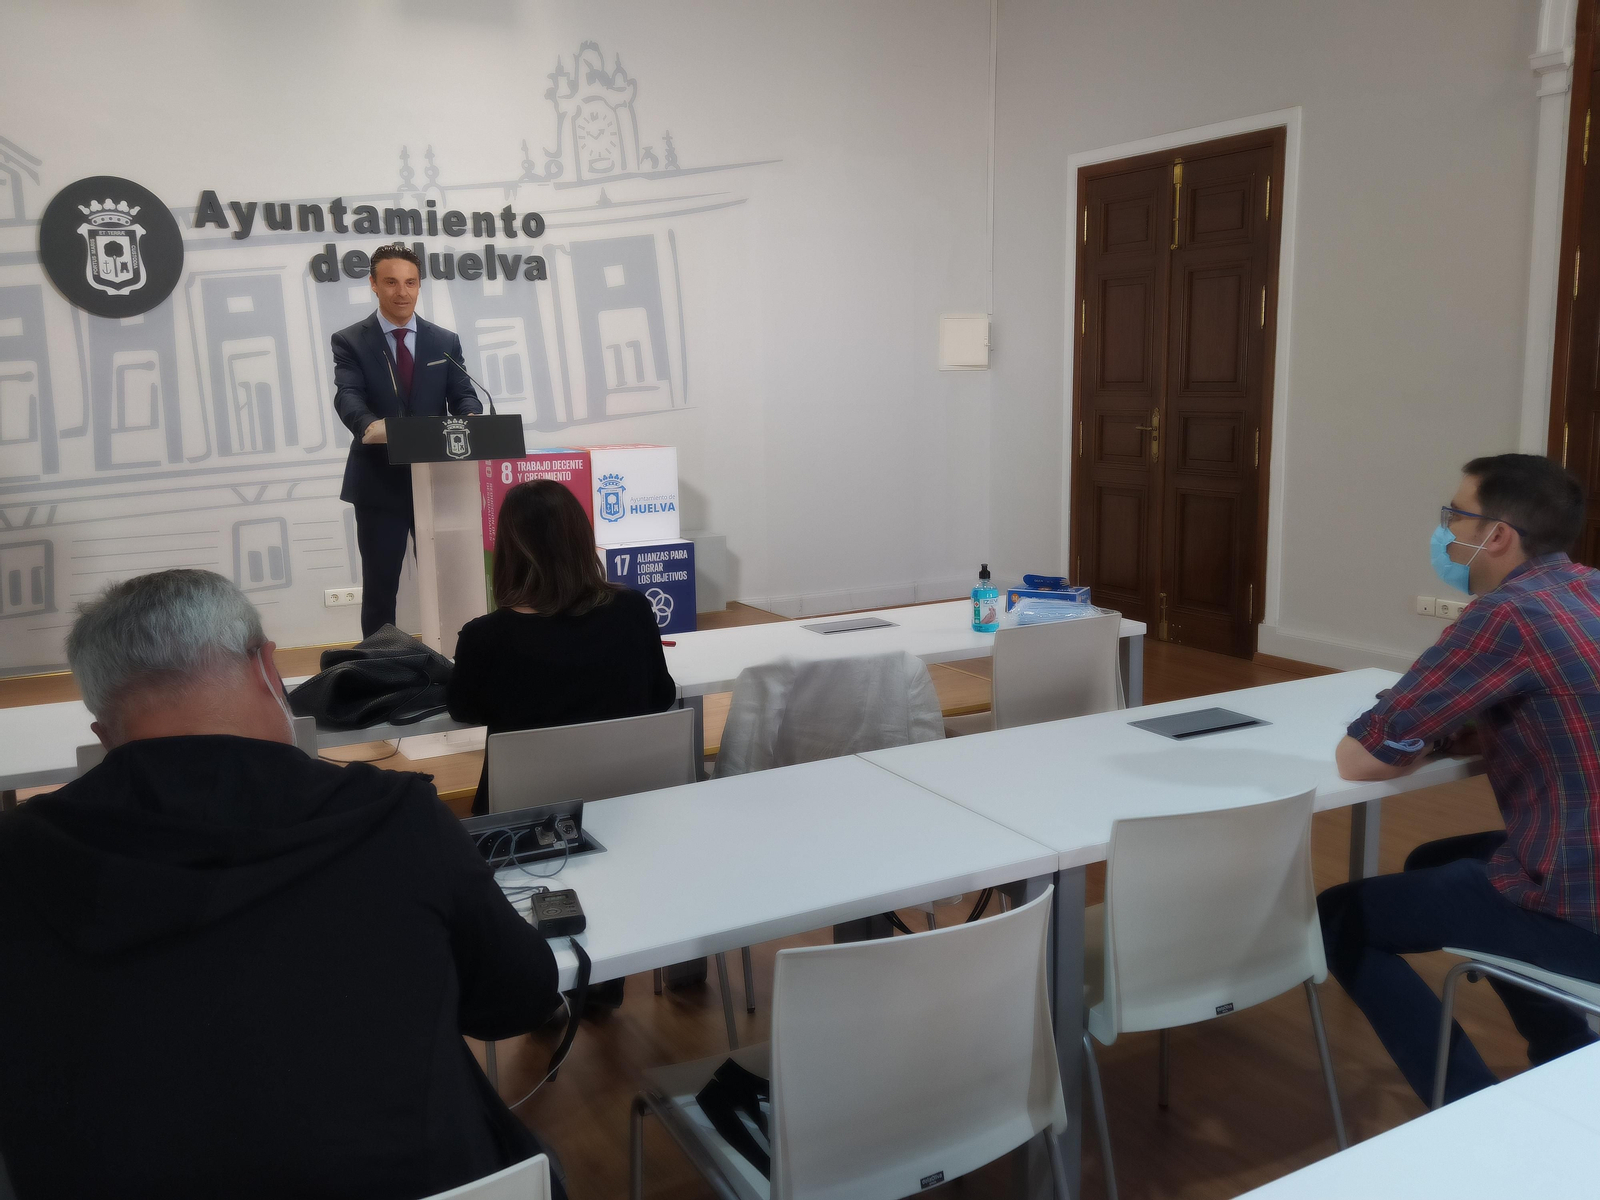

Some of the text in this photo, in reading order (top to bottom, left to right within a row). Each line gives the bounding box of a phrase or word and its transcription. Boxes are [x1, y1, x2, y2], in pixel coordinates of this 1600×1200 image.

[194, 189, 546, 240] Ayuntamiento
[310, 243, 371, 283] de
[501, 462, 513, 484] 8
[517, 460, 583, 472] TRABAJO DECENTE
[517, 471, 572, 482] Y CRECIMIENTO
[630, 494, 668, 503] Ayuntamiento
[630, 502, 676, 514] HUELVA
[637, 549, 688, 563] ALIANZAS PARA
[614, 554, 631, 576] 17
[637, 562, 664, 574] LOGRAR
[637, 570, 688, 585] LOS OBJETIVOS
